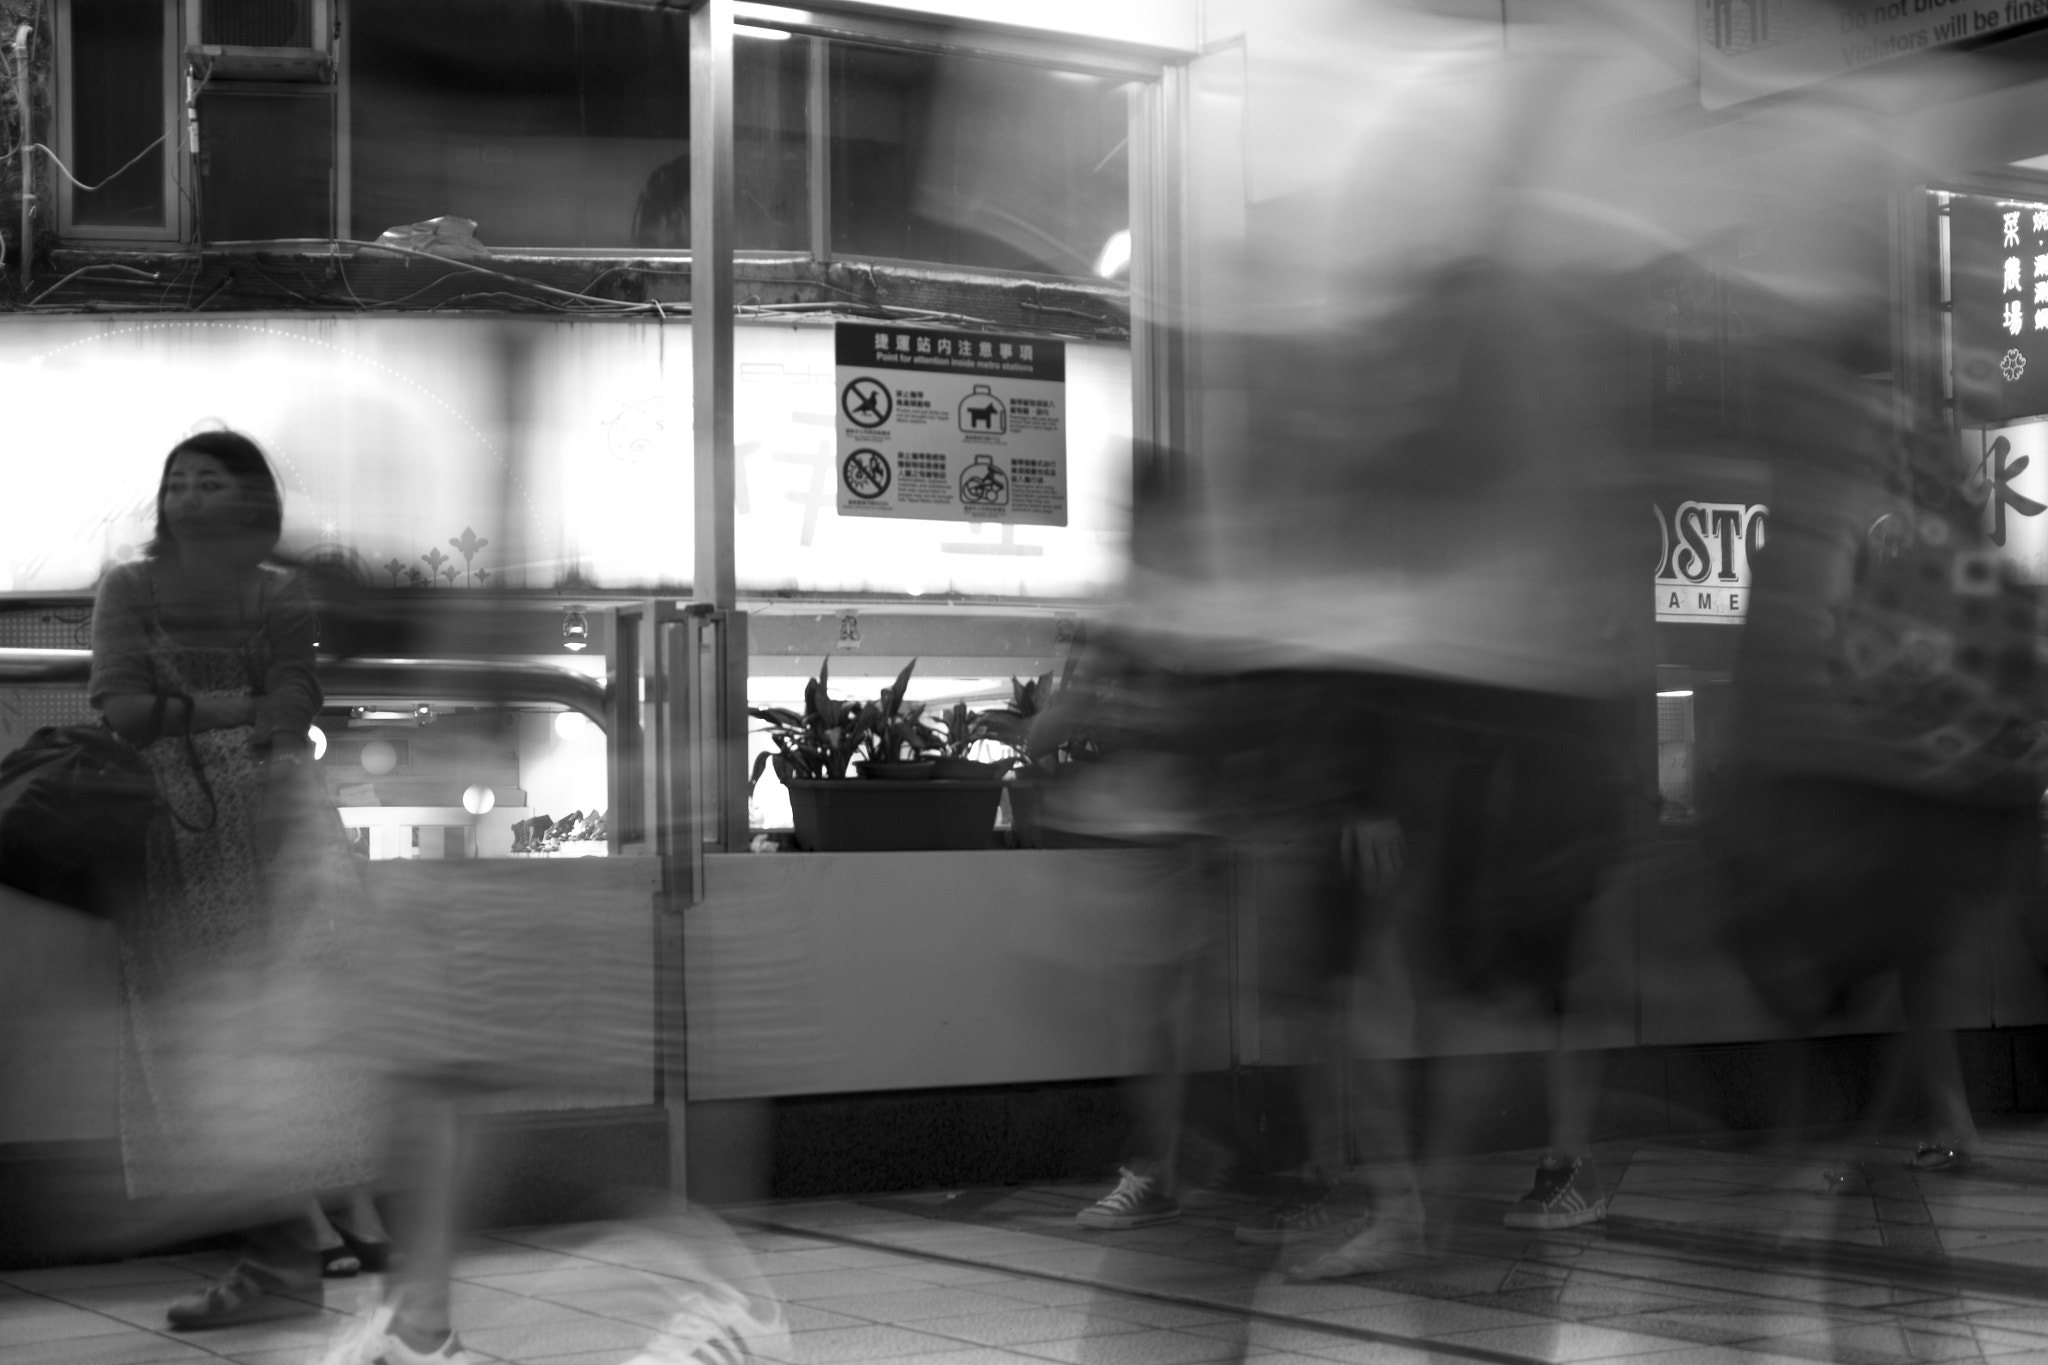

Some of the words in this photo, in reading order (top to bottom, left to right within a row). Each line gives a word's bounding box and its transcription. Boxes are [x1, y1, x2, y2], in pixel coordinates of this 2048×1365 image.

[1840, 11, 1868, 34] Do
[1874, 0, 1908, 25] not
[1840, 29, 1929, 68] Violators
[1933, 13, 1968, 41] will
[1974, 10, 1999, 31] be
[876, 351, 898, 363] Point
[900, 353, 912, 363] for
[913, 354, 950, 366] attention
[951, 357, 975, 368] inside
[977, 360, 1000, 370] metro
[1002, 361, 1034, 372] stations
